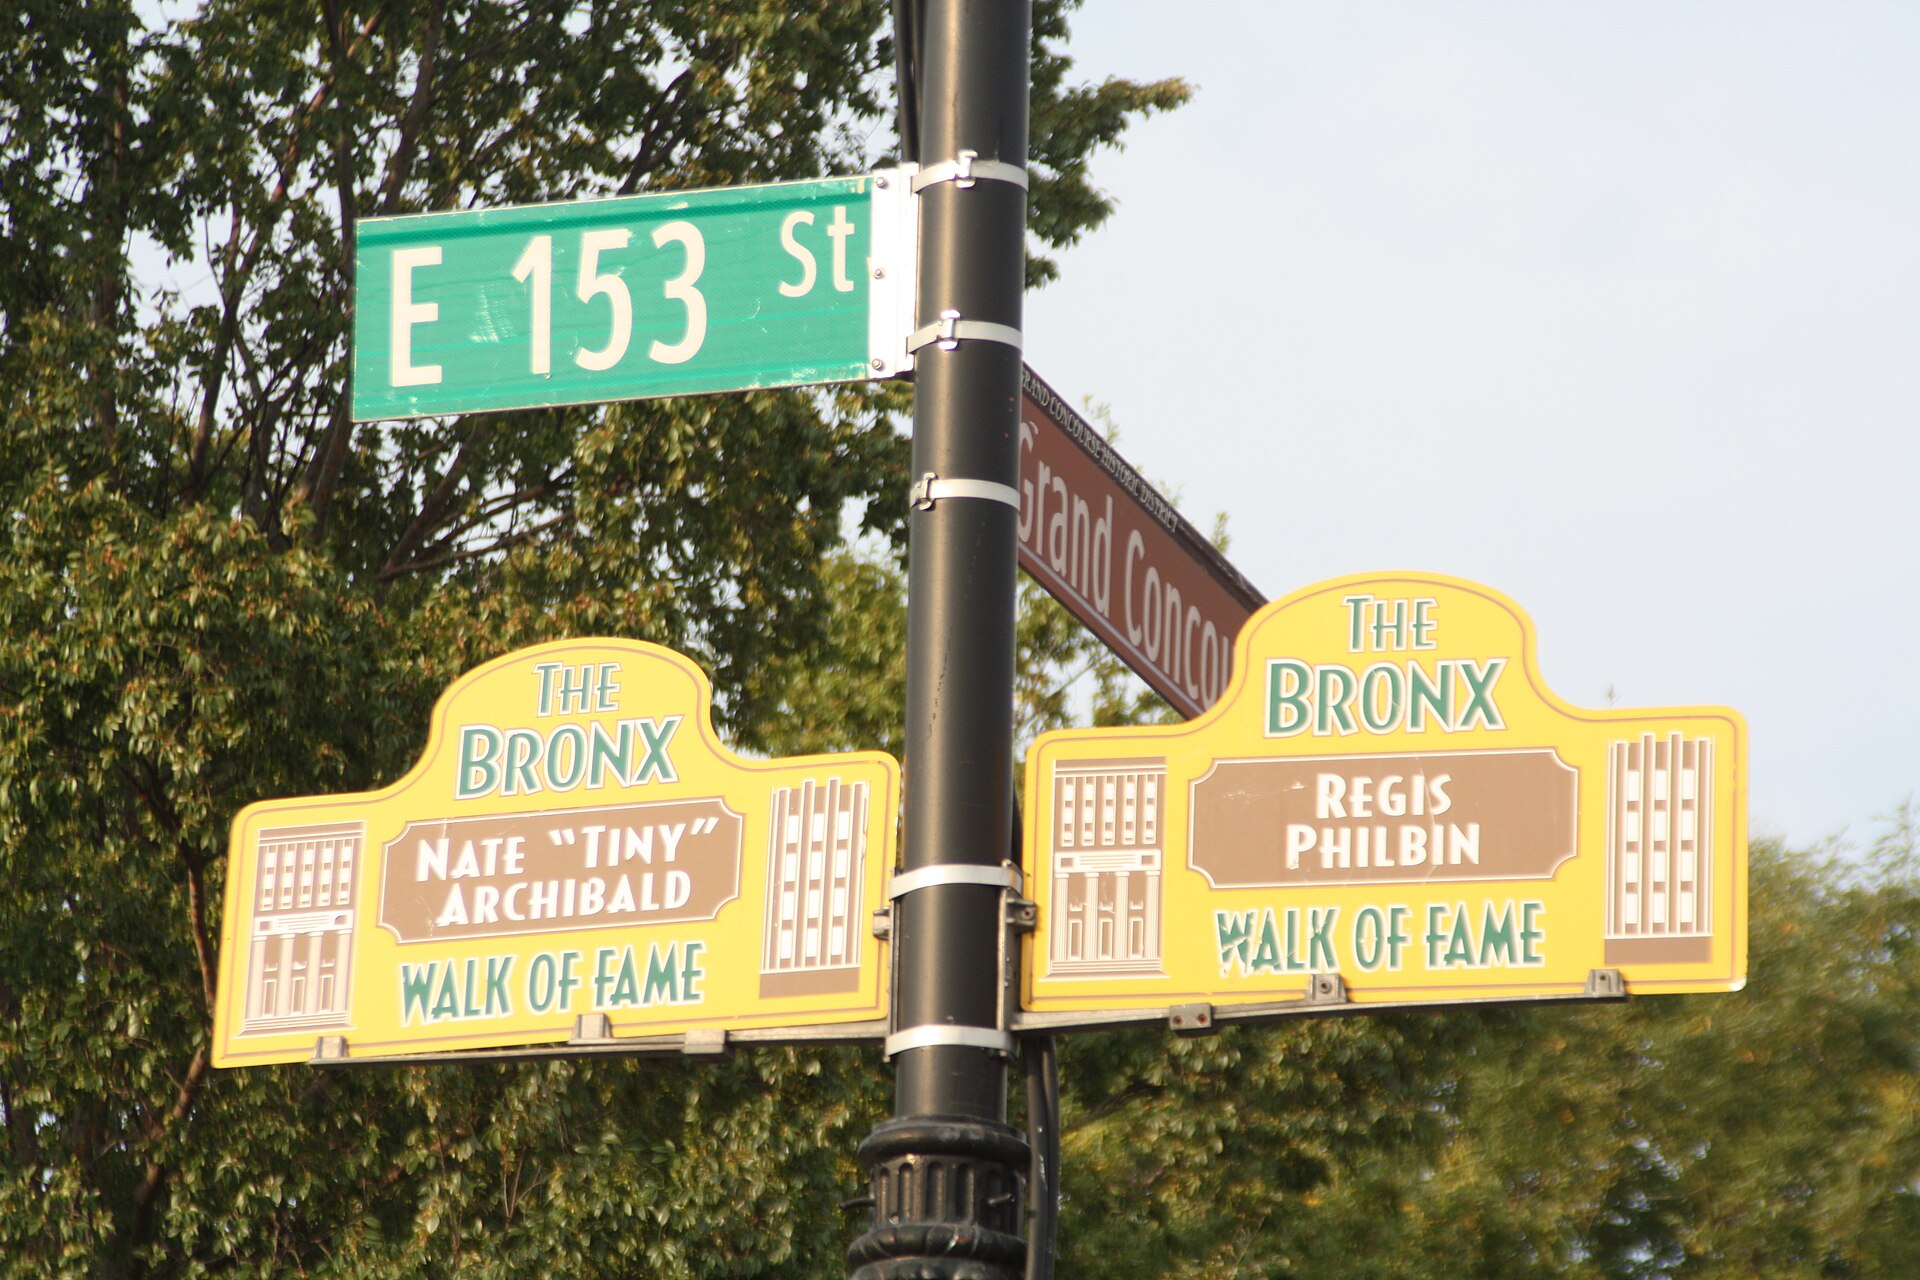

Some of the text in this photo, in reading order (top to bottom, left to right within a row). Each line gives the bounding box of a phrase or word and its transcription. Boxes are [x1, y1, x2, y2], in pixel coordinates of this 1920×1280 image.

[389, 205, 855, 387] E 153 St
[1022, 368, 1179, 534] RAND CONCOURSE HISTORIC DISTRICT
[1344, 594, 1439, 653] THE
[534, 662, 621, 717] THE
[1263, 657, 1509, 738] BRONX
[456, 714, 683, 800] BRONX
[1315, 772, 1453, 820] REGIS
[415, 836, 526, 882] NATE
[1285, 823, 1481, 871] PHILBIN
[434, 870, 692, 928] ARCHIBALD
[1214, 900, 1546, 977] WALK OF FAME
[401, 941, 707, 1027] WALK OF FAME
